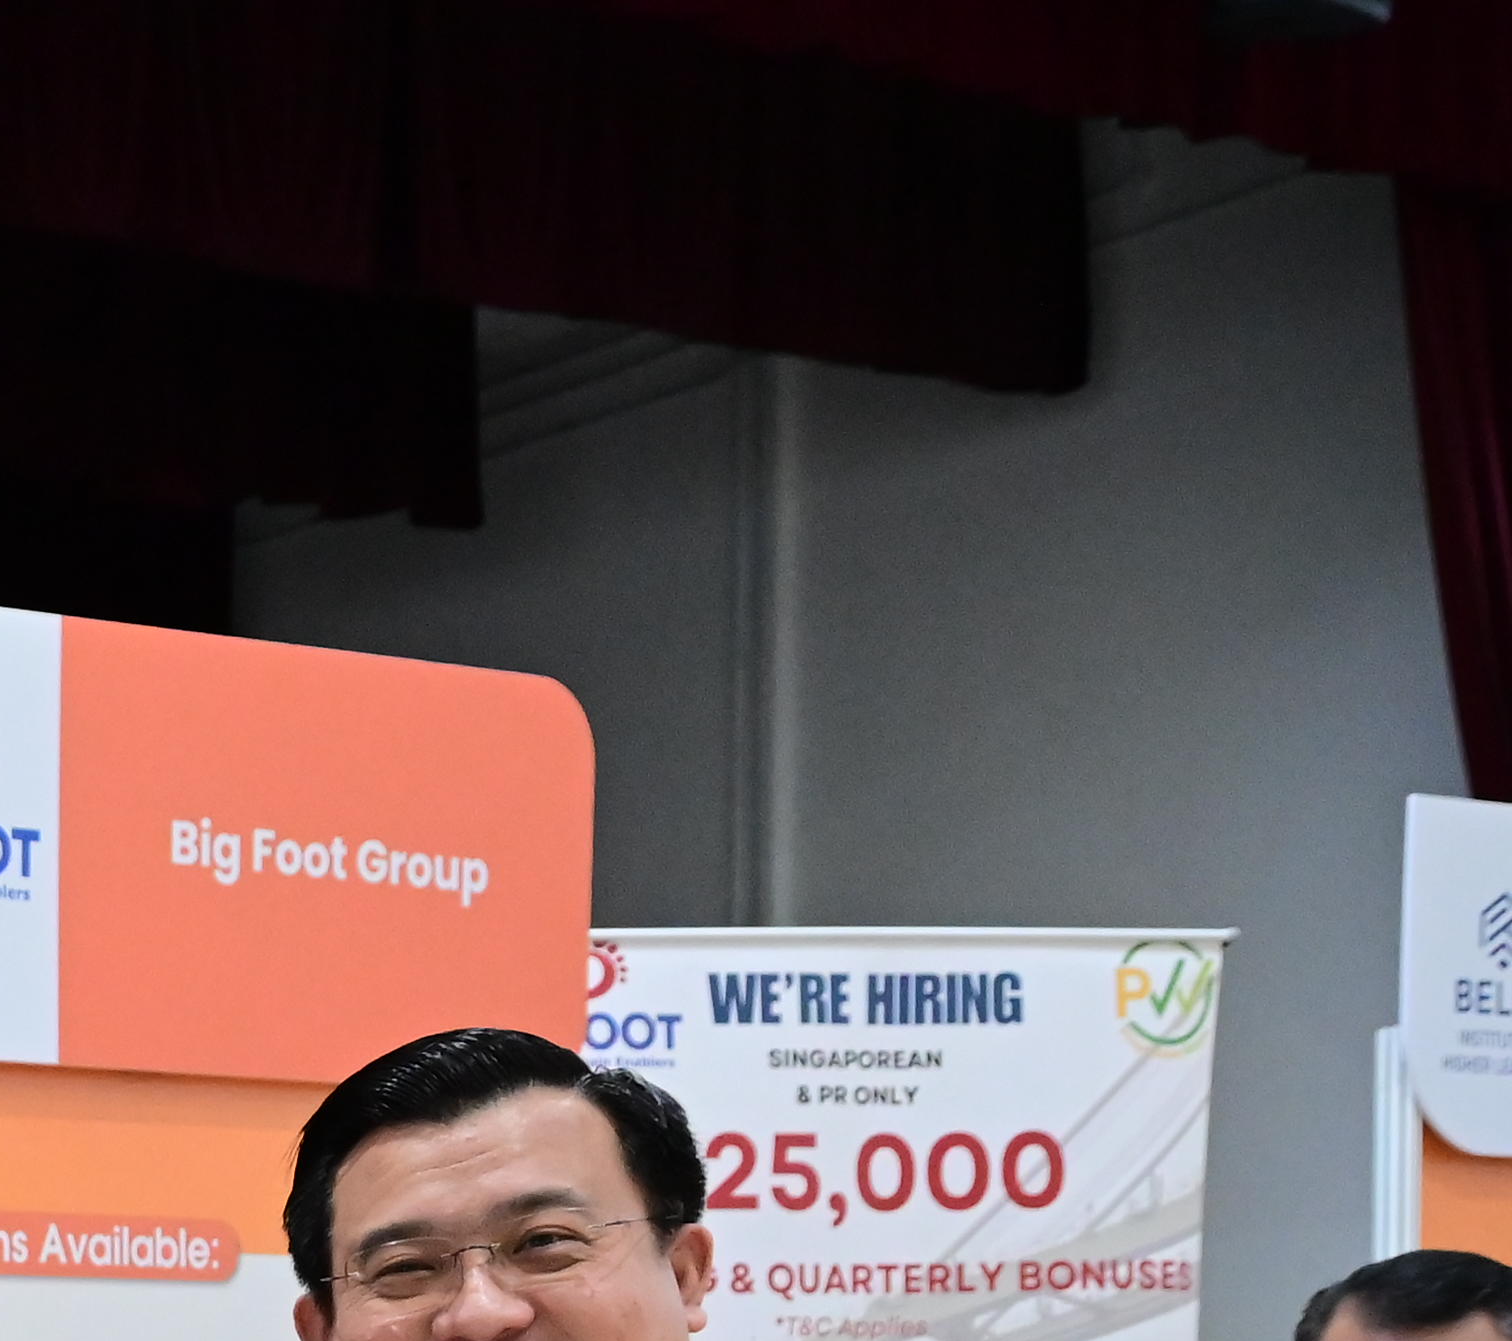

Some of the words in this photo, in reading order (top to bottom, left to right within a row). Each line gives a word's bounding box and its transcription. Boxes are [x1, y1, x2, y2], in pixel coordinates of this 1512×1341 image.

[171, 819, 241, 885] Big
[252, 828, 348, 882] Foot
[357, 839, 489, 909] Group
[708, 971, 851, 1027] WE'RE
[866, 971, 1025, 1027] HIRING
[768, 1047, 944, 1072] SINGAPOREAN
[797, 1085, 813, 1106] &
[818, 1084, 850, 1106] PR
[853, 1084, 920, 1107] ONLY
[39, 1221, 222, 1273] Available:
[730, 1263, 755, 1294] &
[766, 1261, 1004, 1301] QUARTERLY
[1019, 1259, 1194, 1293] BONUSES
